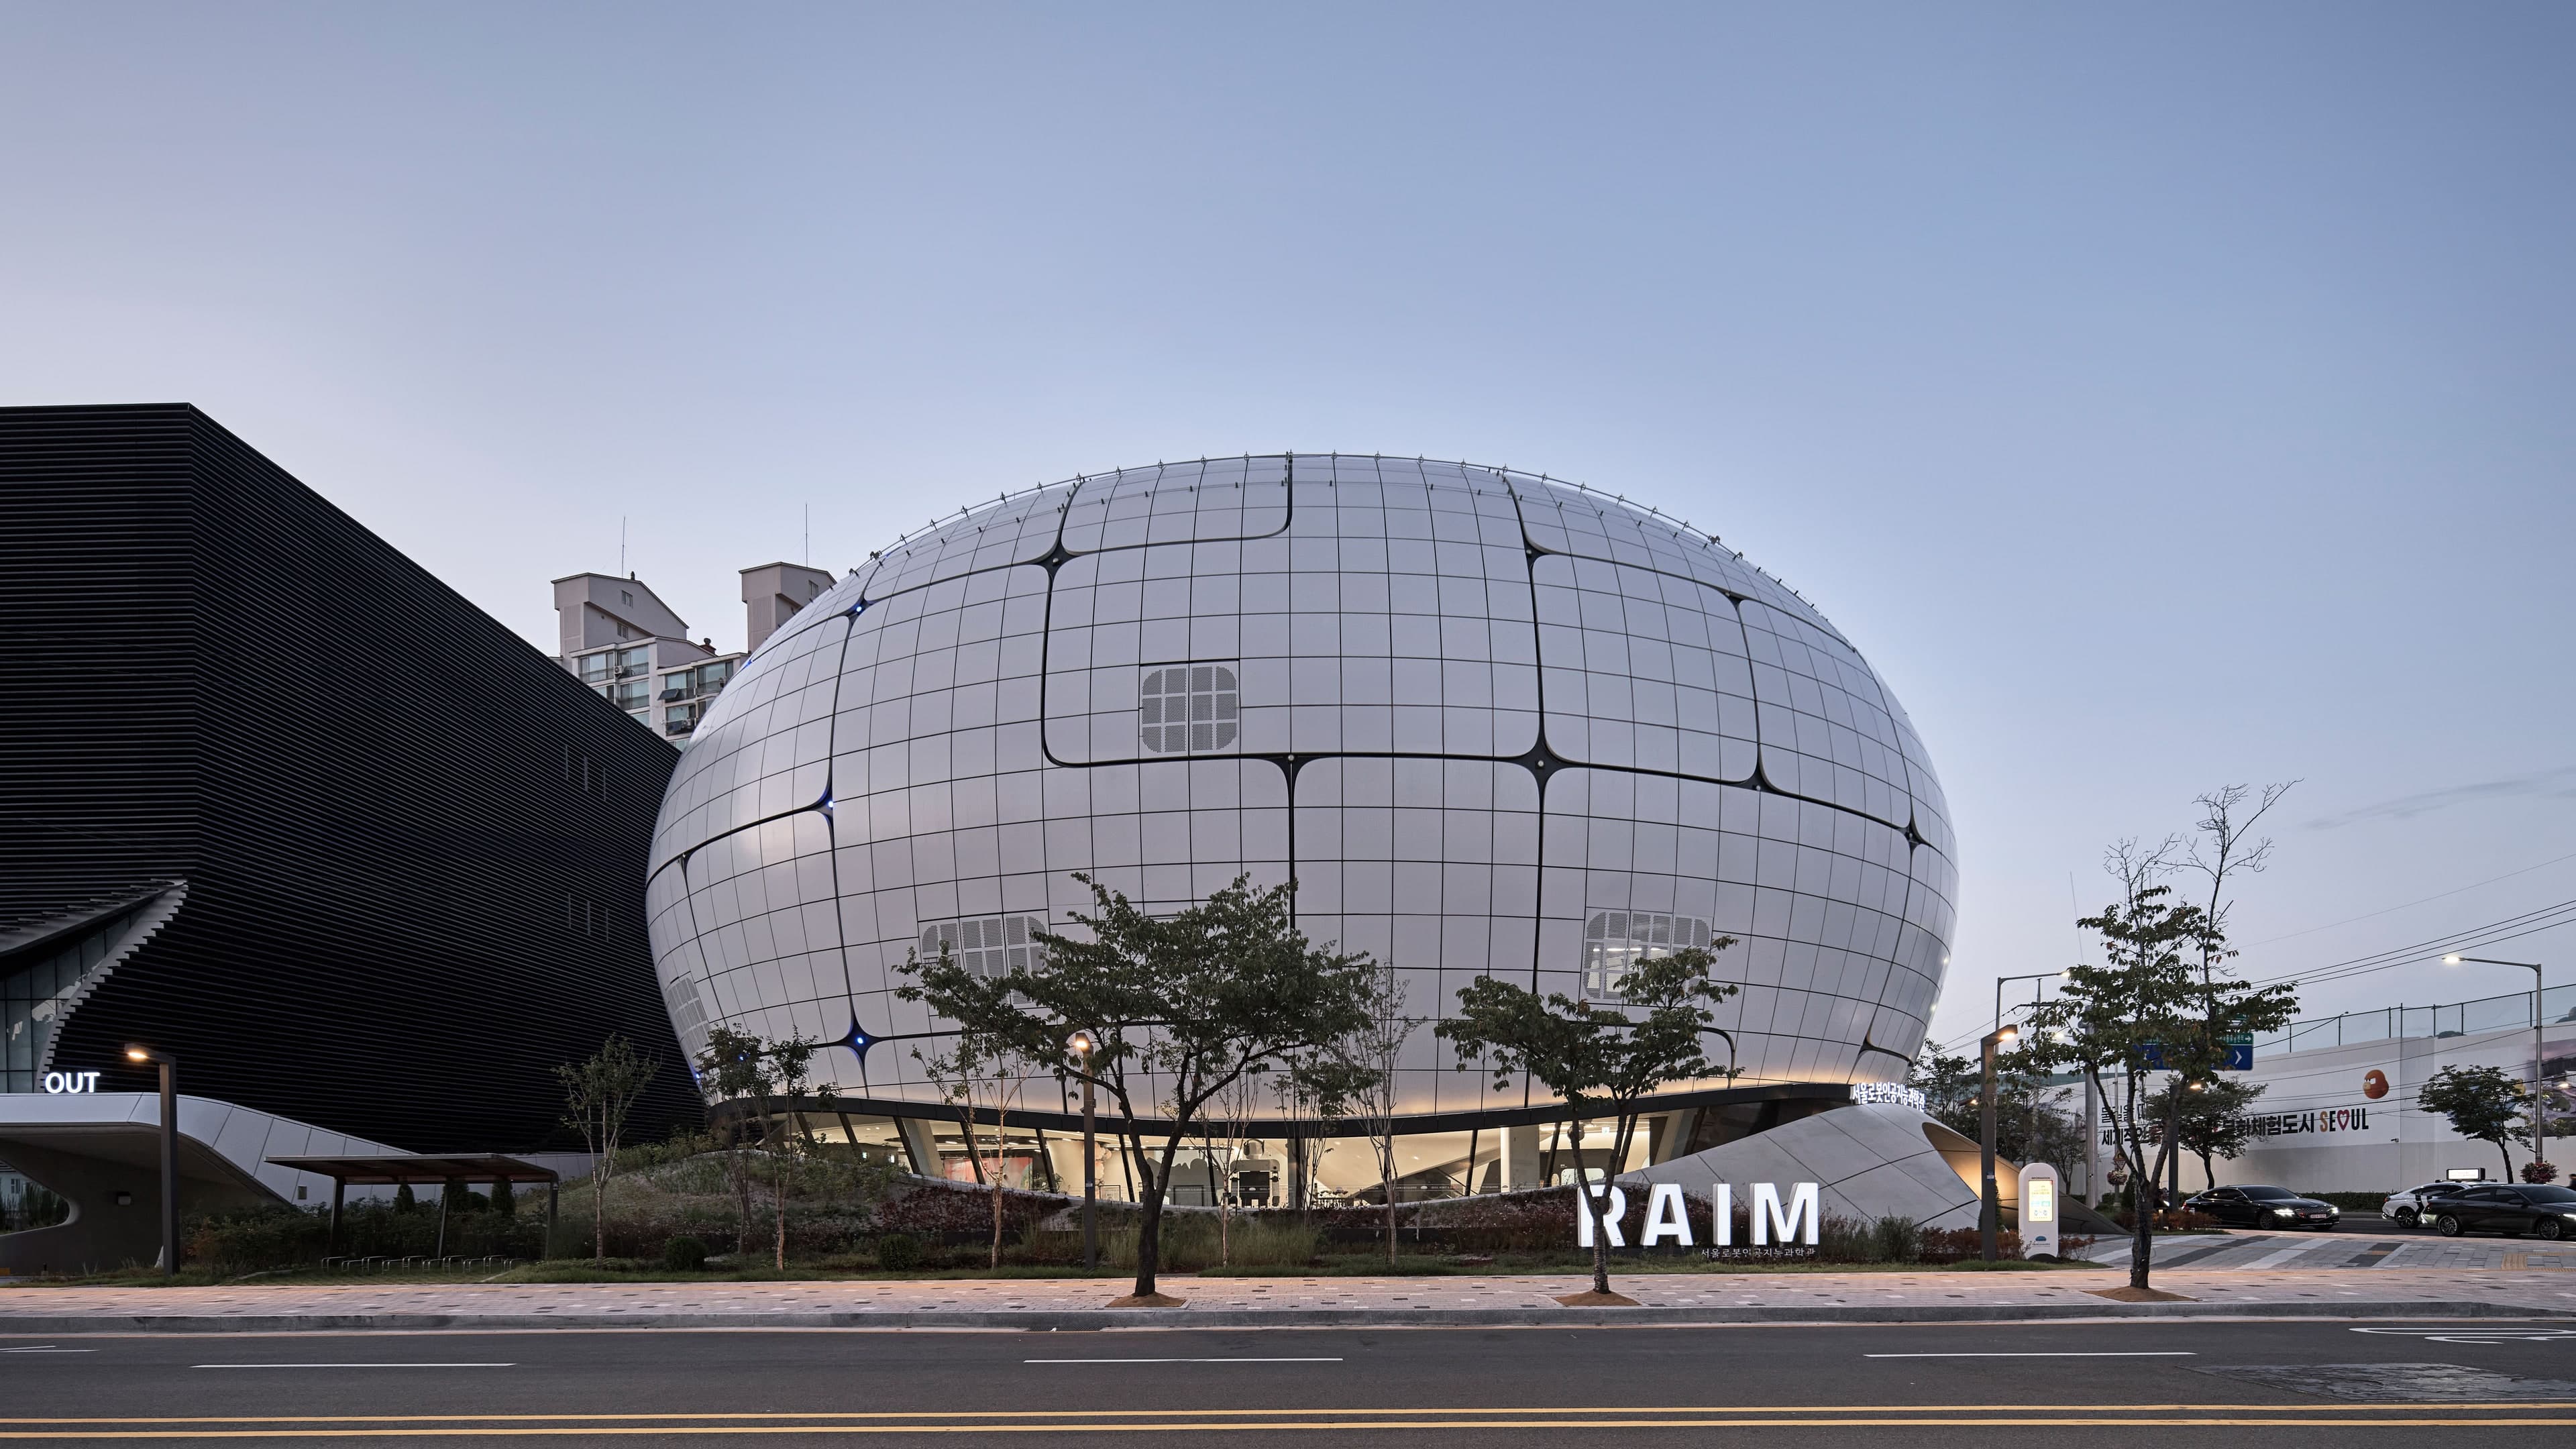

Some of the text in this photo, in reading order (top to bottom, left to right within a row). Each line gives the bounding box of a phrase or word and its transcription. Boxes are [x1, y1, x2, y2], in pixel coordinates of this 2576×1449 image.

[45, 1072, 101, 1093] OUT
[1852, 1081, 1925, 1112] 서울로봇인공지능과학관
[1578, 1183, 1819, 1247] RAIM
